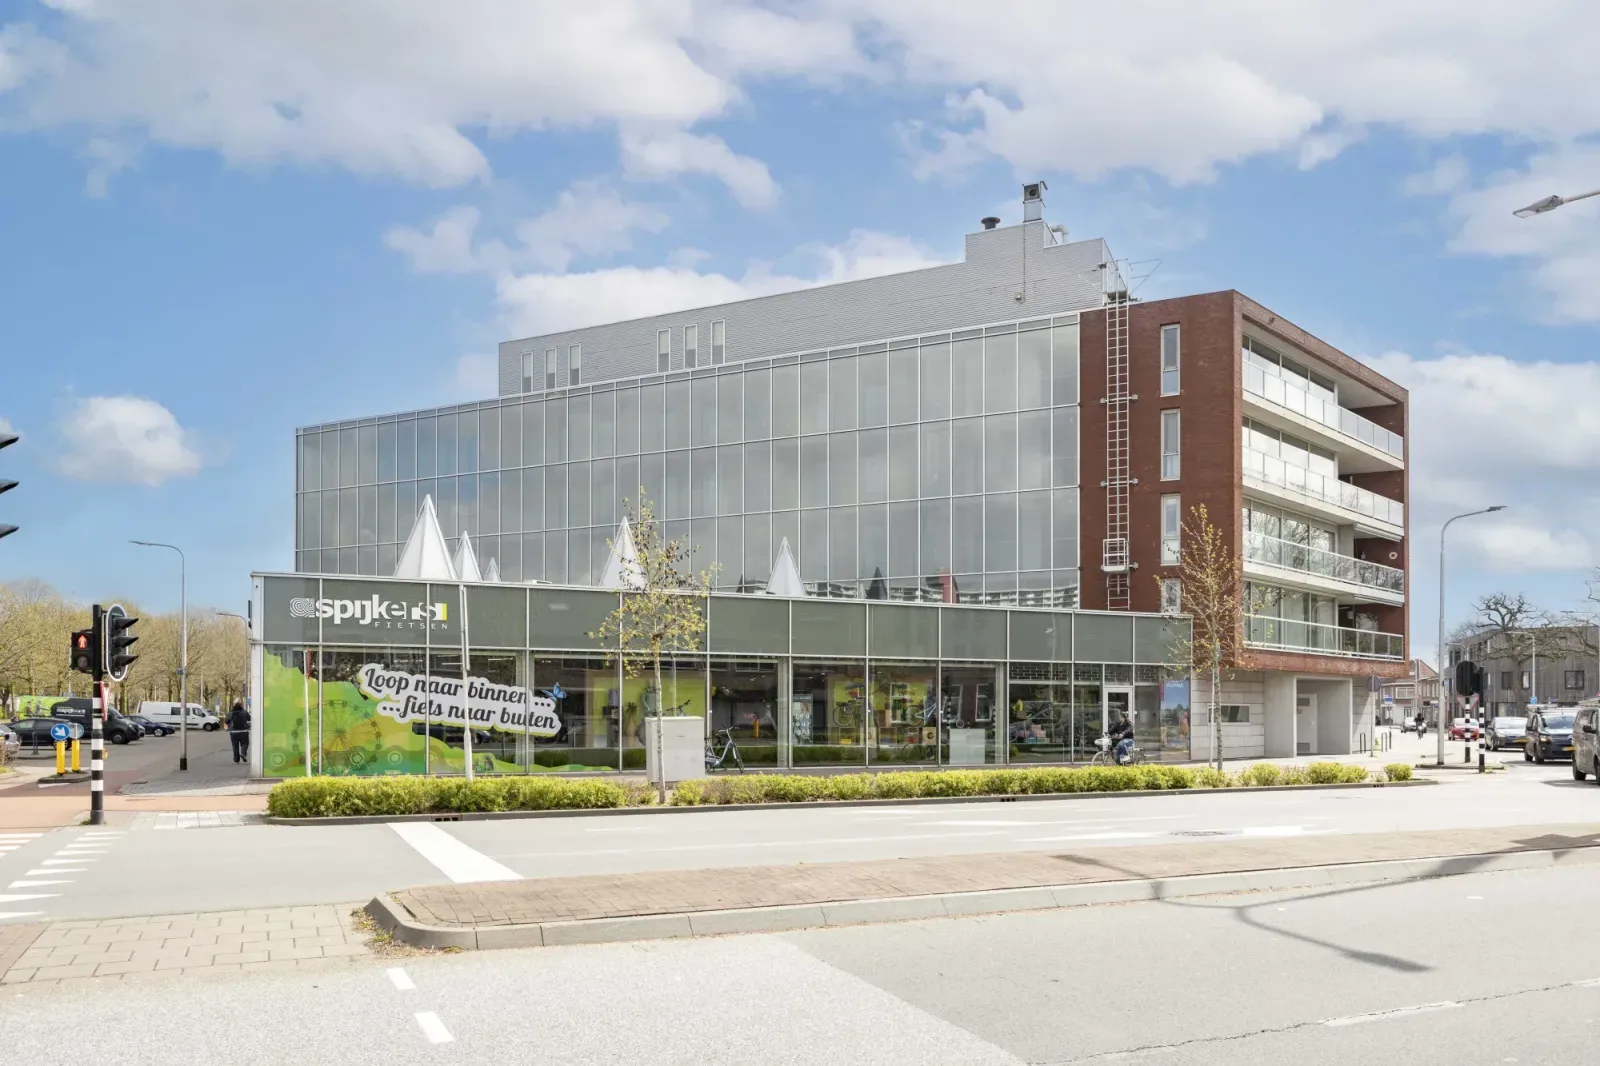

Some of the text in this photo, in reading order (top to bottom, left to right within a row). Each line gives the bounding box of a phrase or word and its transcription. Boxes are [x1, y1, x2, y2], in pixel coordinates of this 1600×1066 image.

[374, 621, 448, 630] FIETSEN
[365, 668, 409, 695] Loop
[414, 679, 463, 696] naar
[447, 705, 496, 722] naar
